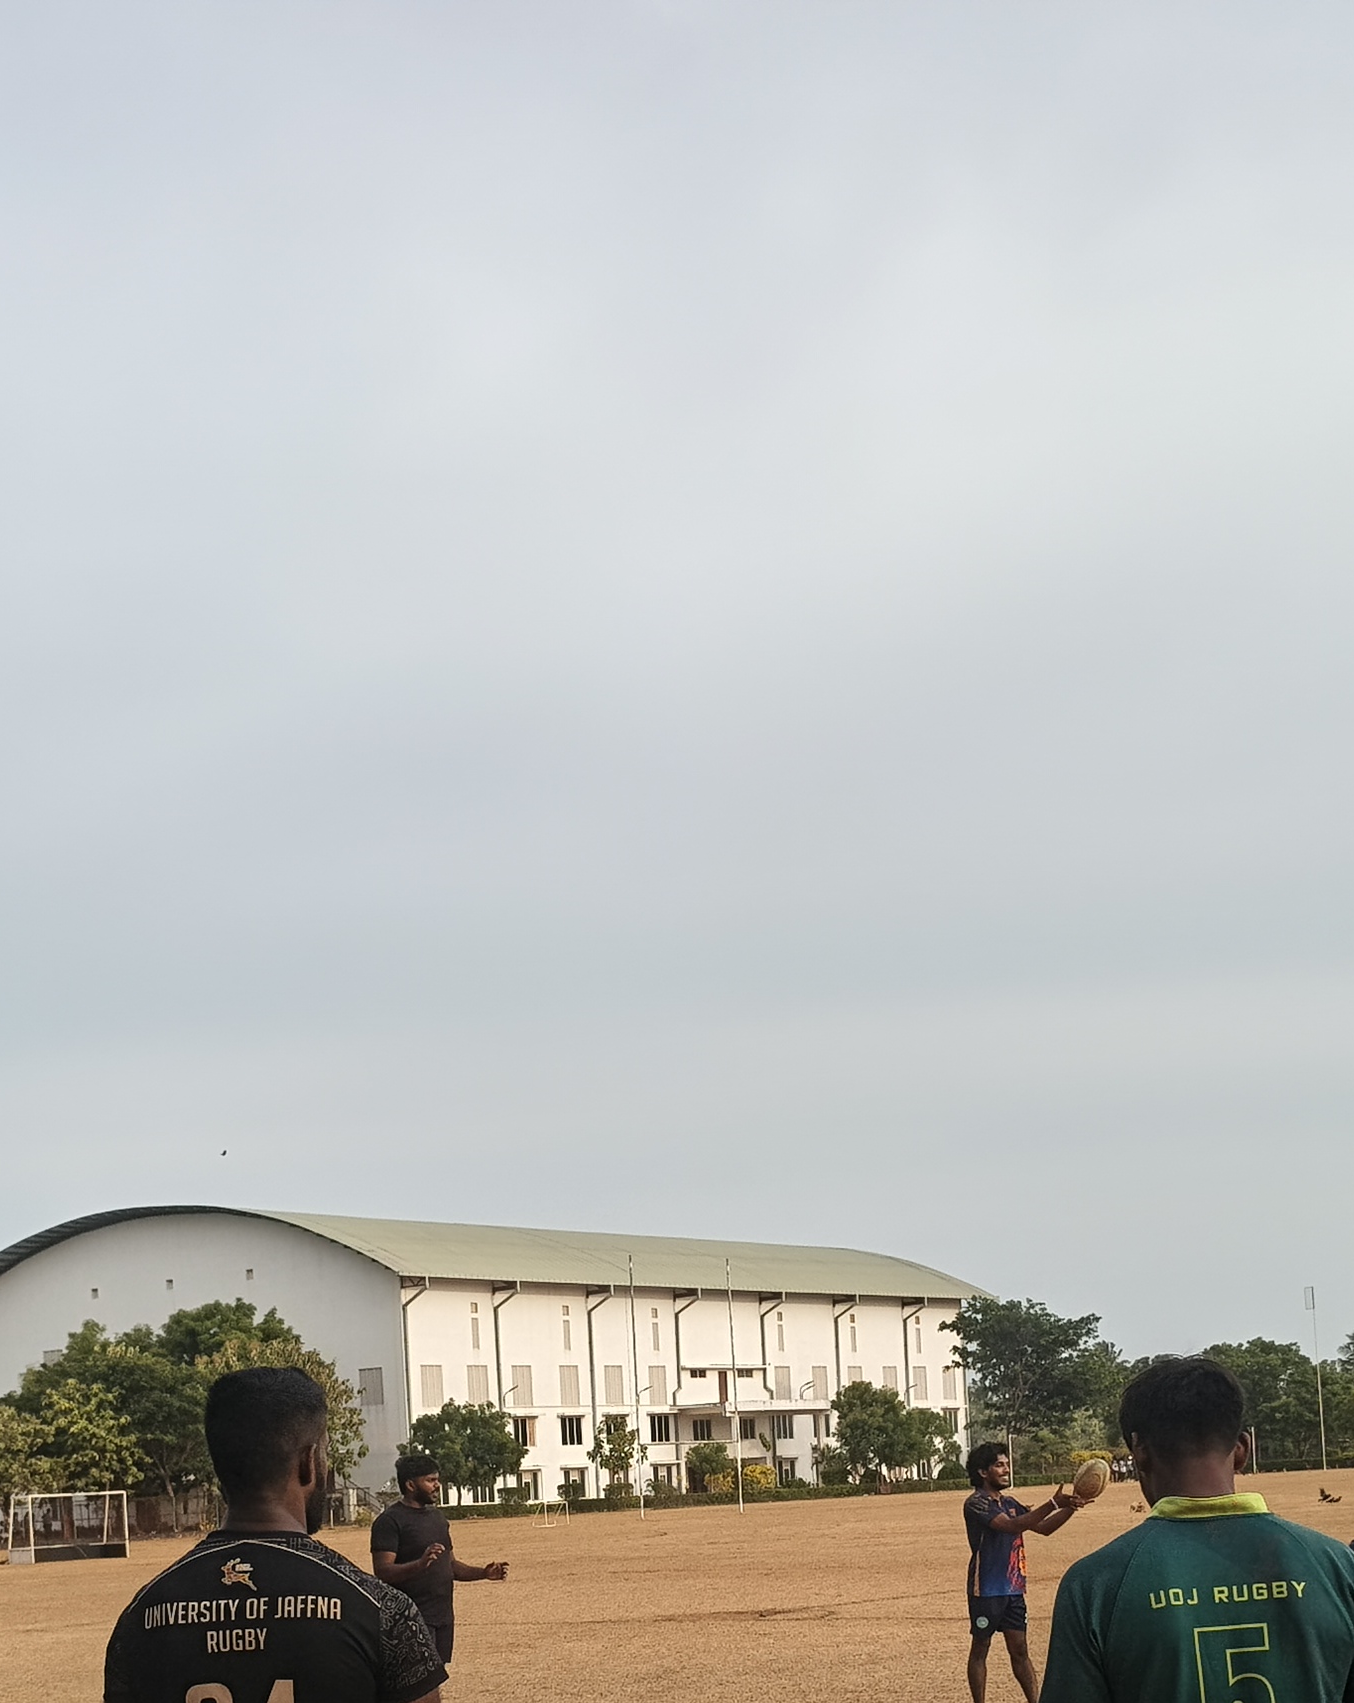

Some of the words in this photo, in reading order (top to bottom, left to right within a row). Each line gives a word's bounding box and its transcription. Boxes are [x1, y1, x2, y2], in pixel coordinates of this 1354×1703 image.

[1149, 1588, 1199, 1609] UOJ
[1213, 1580, 1307, 1603] RUGBY
[144, 1598, 240, 1630] UNIVERSITY
[246, 1597, 269, 1620] OF
[274, 1595, 342, 1620] JAFFNA
[206, 1628, 268, 1654] RUGBY
